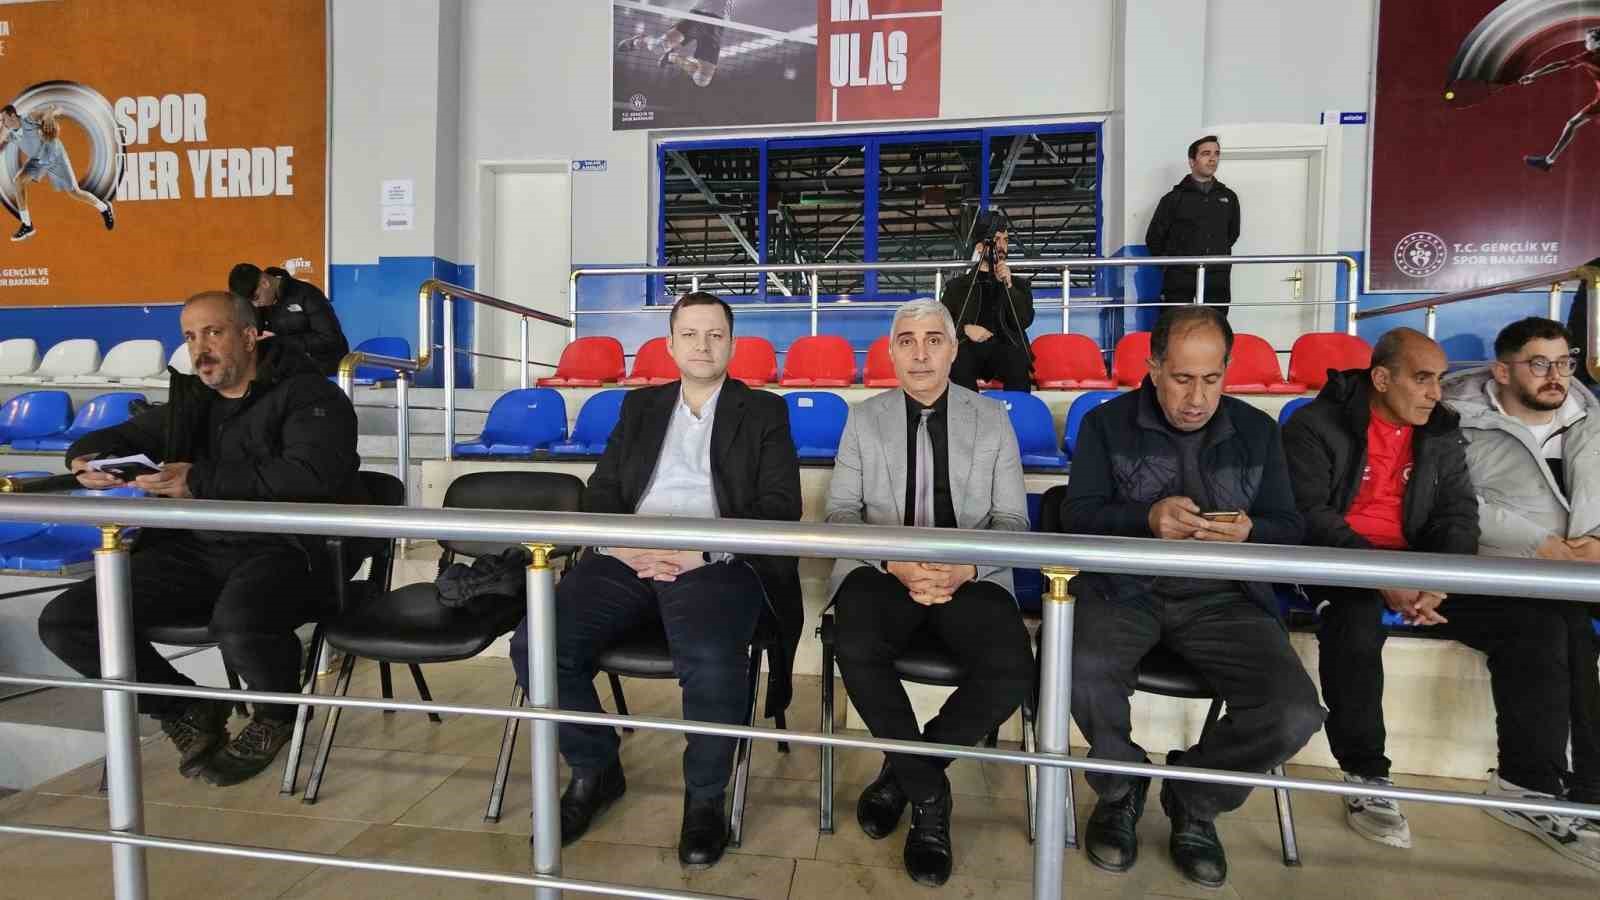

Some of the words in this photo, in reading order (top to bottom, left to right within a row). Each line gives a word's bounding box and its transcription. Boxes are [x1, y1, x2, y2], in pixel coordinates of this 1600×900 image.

[830, 30, 908, 91] ULAŞ
[114, 93, 208, 146] SPOR
[115, 150, 181, 201] HER
[186, 146, 294, 198] YERDE
[1453, 243, 1478, 253] T.C.
[1480, 240, 1537, 254] GENÇLİK
[1541, 242, 1560, 252] VE
[1453, 255, 1488, 265] SPOR
[1490, 254, 1557, 264] BAKANLIĞI
